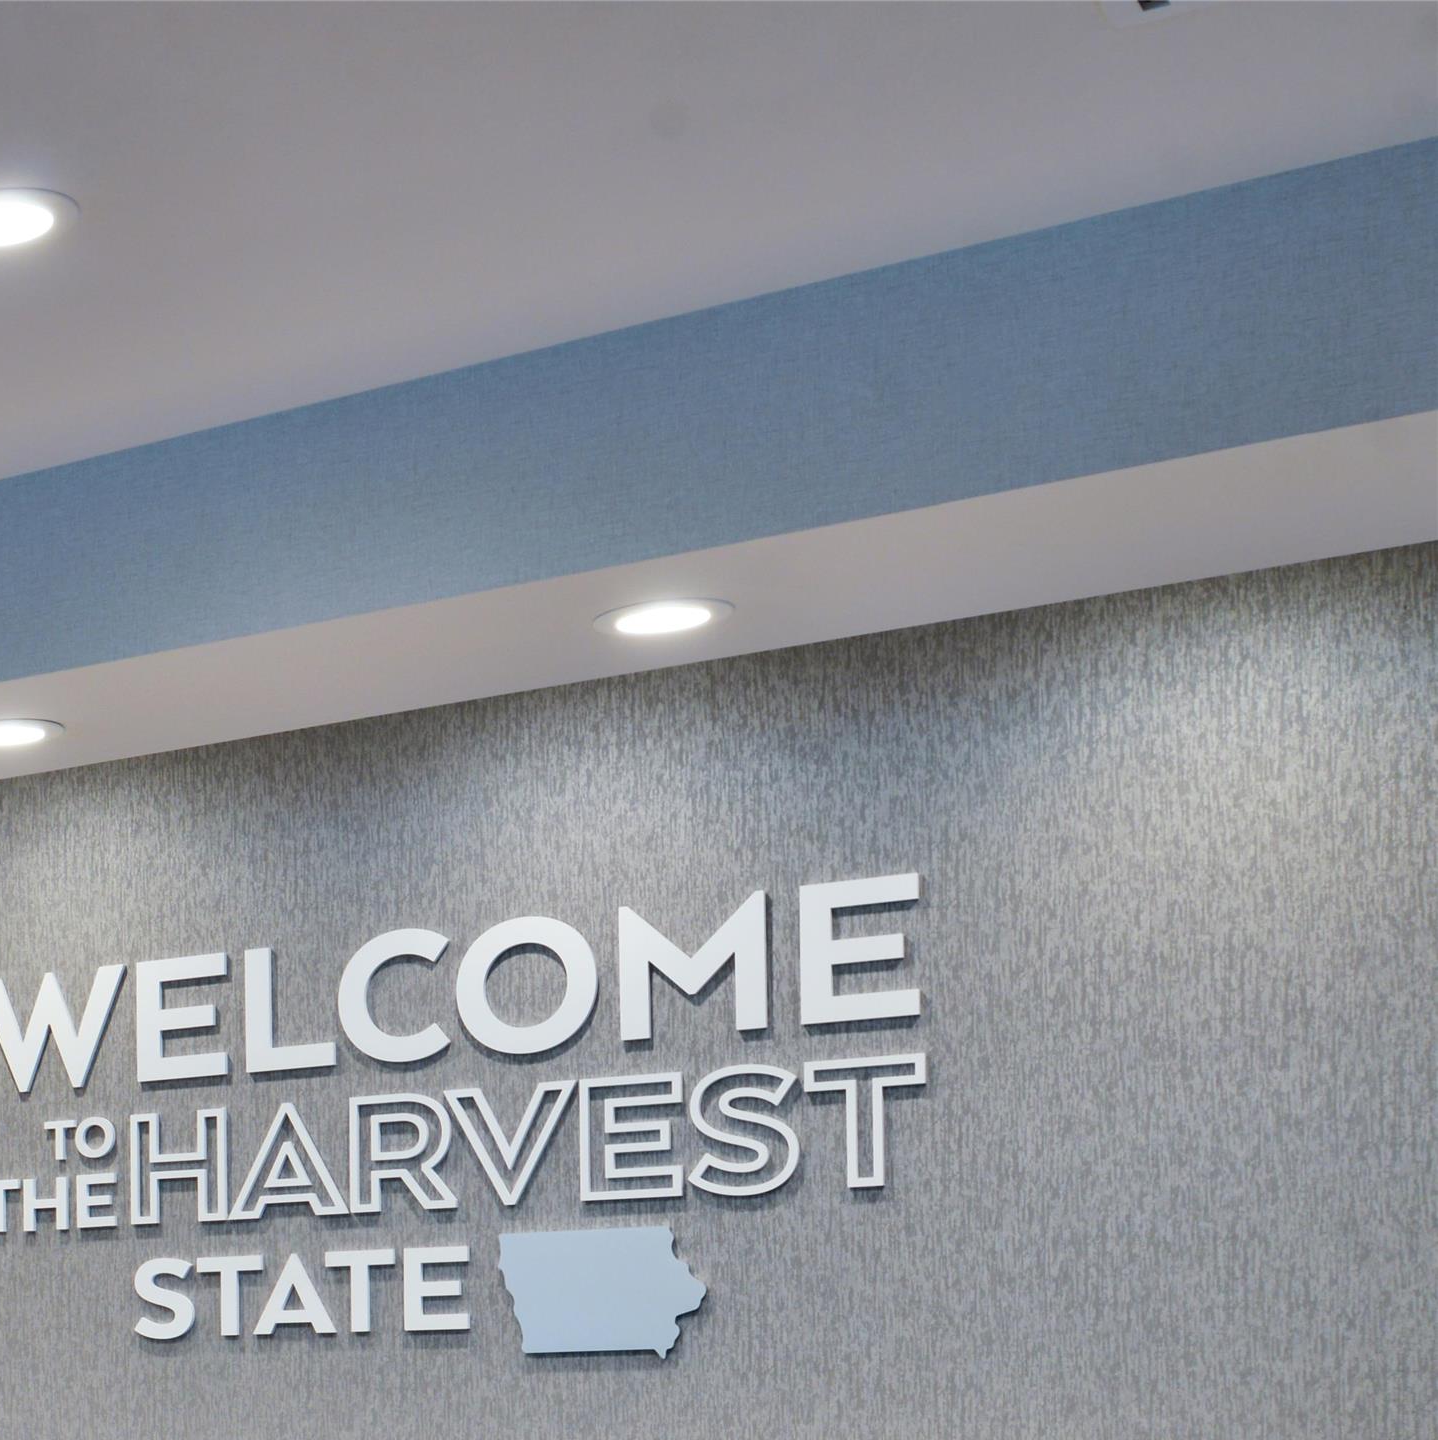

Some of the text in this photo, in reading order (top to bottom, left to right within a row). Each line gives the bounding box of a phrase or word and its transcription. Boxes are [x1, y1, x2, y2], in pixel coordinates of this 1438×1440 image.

[44, 1115, 116, 1162] TO
[129, 1052, 926, 1226] HARVEST
[133, 1244, 470, 1340] STATE
